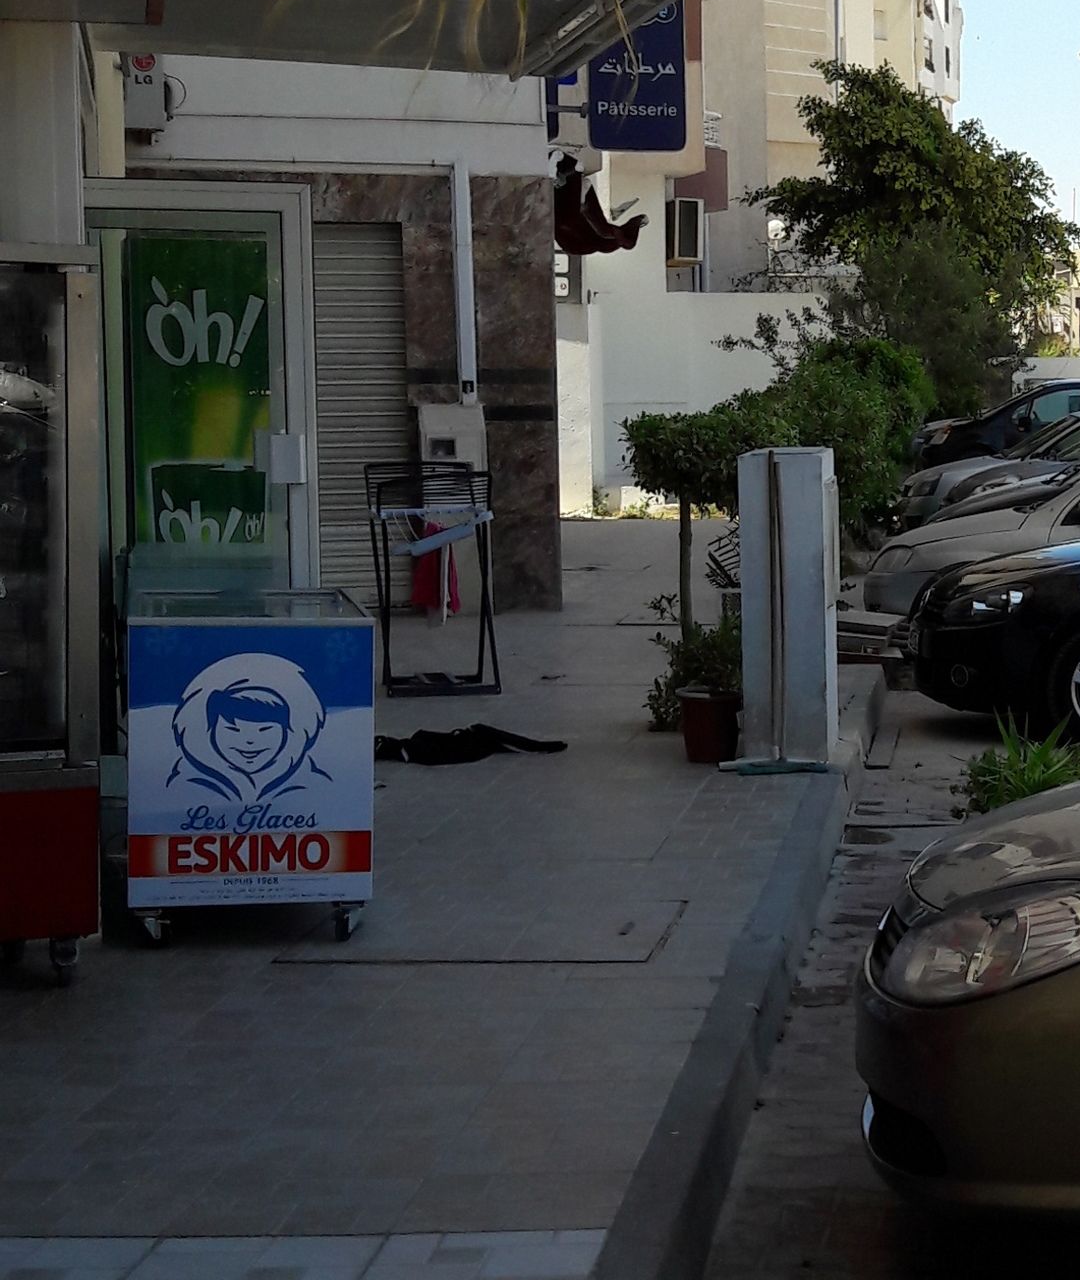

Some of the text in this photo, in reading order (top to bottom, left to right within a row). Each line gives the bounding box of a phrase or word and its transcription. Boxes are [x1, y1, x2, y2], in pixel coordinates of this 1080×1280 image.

[134, 74, 153, 85] LG
[599, 51, 676, 81] مرطبات
[597, 101, 677, 117] Pâtisserie
[181, 803, 318, 834] Les Glaces
[168, 834, 330, 874] ESKIMO
